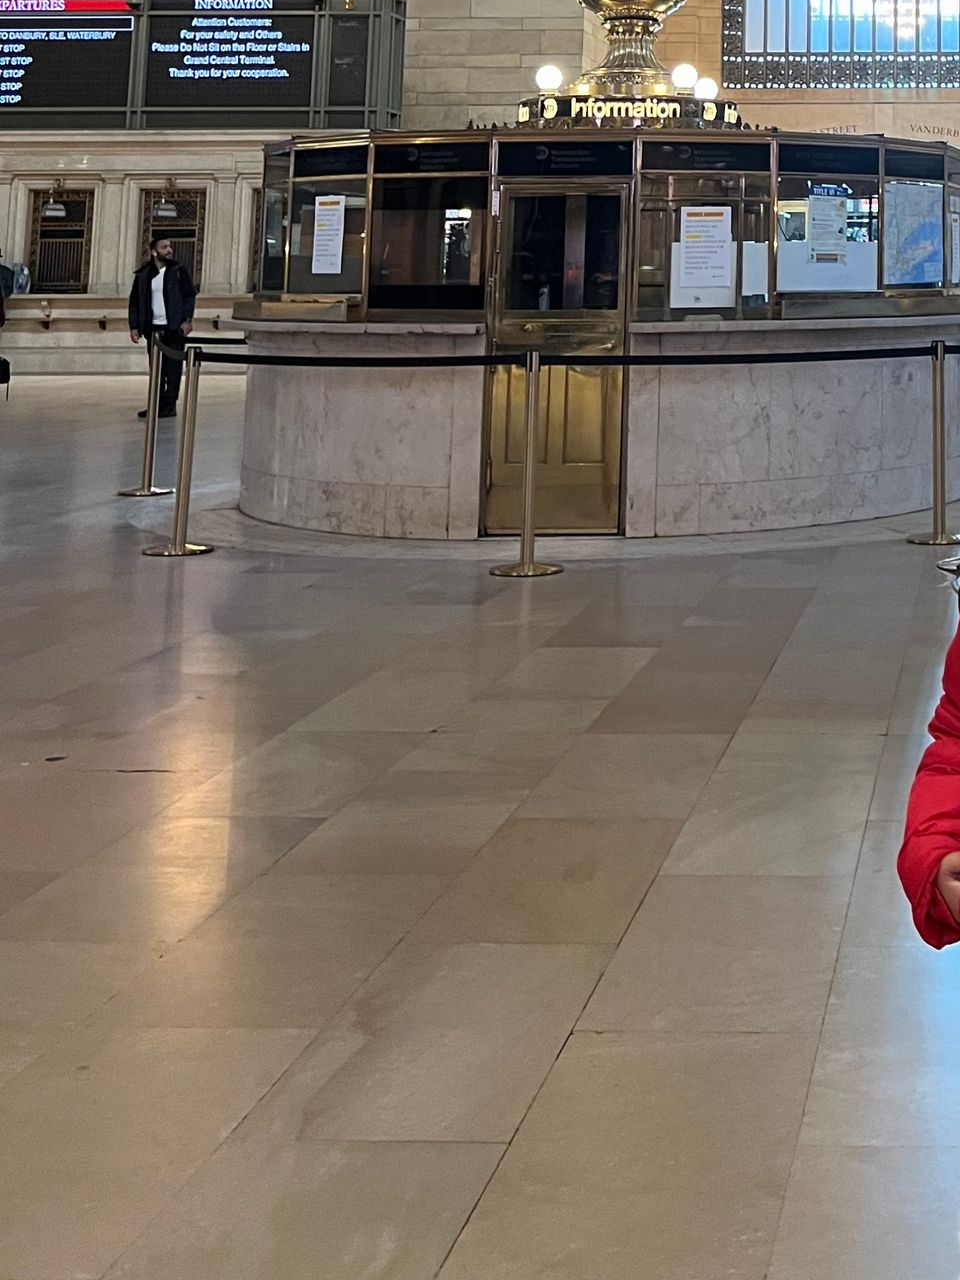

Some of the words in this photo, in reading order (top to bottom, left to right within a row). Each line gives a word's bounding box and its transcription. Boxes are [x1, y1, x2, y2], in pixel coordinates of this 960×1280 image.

[0, 0, 65, 11] PARTURES
[194, 0, 273, 9] INFORMATION
[191, 17, 227, 26] Attention
[228, 17, 272, 26] Customers:
[9, 32, 48, 40] DANBURY,
[67, 32, 116, 40] WATERBURY
[180, 30, 194, 39] For
[196, 32, 214, 40] your
[239, 30, 254, 39] and
[256, 30, 282, 39] Others
[3, 44, 26, 52] STOP
[152, 42, 178, 52] Please
[180, 42, 192, 52] Do
[193, 42, 207, 52] Not
[220, 44, 231, 52] on
[232, 42, 245, 52] the
[246, 42, 267, 52] Floor
[11, 57, 33, 65] STOP
[184, 55, 209, 64] Grand
[210, 55, 238, 64] Central
[3, 70, 25, 78] STOP
[168, 68, 194, 77] Thank
[194, 70, 209, 79] you
[211, 68, 222, 77] for
[222, 70, 240, 79] your
[0, 82, 23, 90] STOP
[0, 95, 21, 103] STOP
[571, 98, 681, 118] Information
[820, 125, 858, 134] STREET
